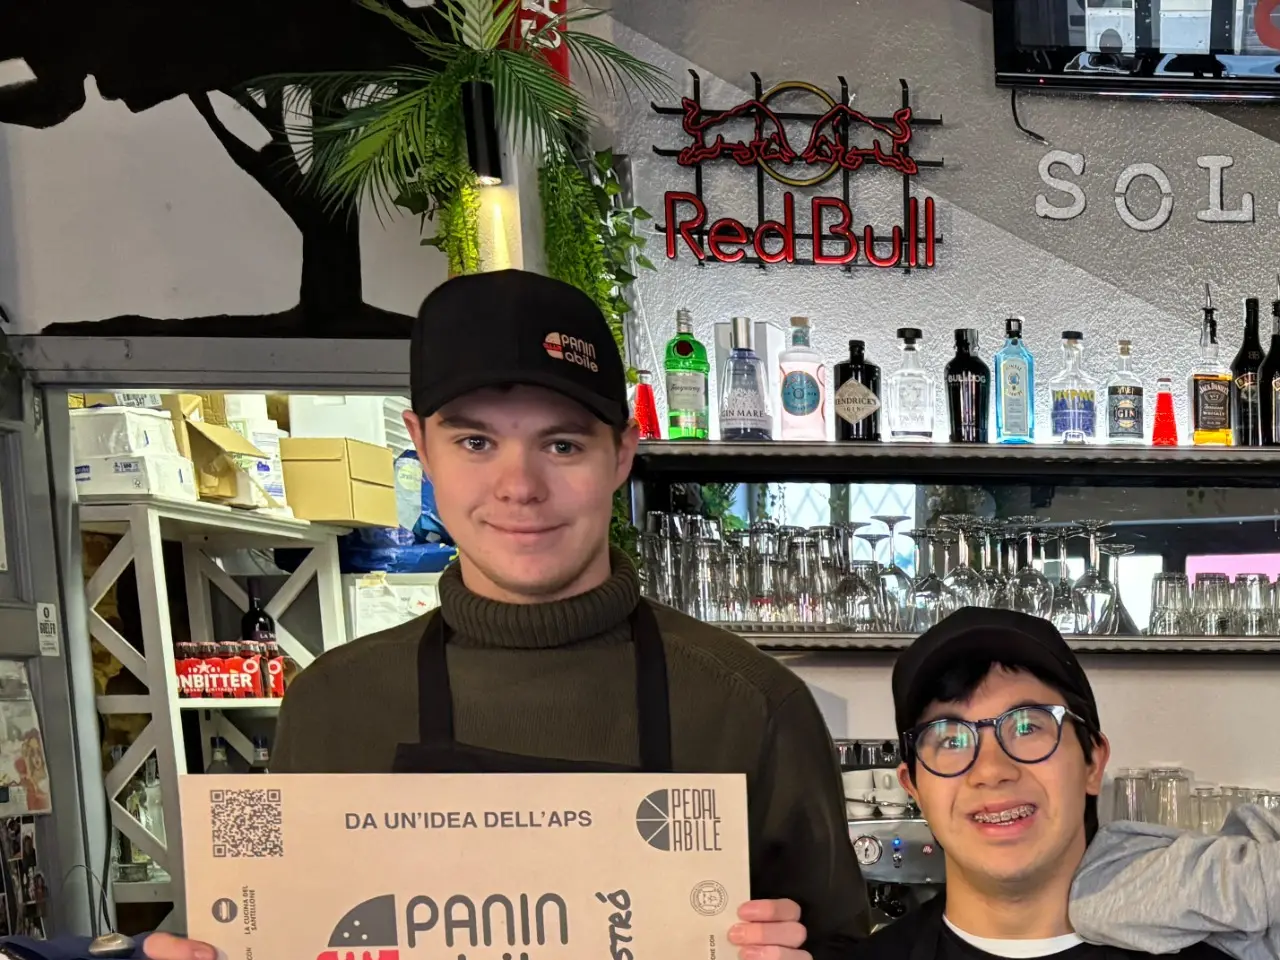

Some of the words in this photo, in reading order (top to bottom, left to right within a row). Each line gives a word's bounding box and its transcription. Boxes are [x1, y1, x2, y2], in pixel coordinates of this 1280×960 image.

[664, 190, 795, 264] Red
[811, 196, 934, 268] Bull
[561, 334, 596, 360] PANIN
[565, 351, 599, 372] abile
[948, 374, 987, 383] BULLDOG
[737, 409, 764, 417] MARE
[1117, 409, 1135, 418] GIN
[672, 789, 721, 820] PEDAL
[344, 811, 379, 831] DA
[384, 810, 477, 830] UN'IDEA
[483, 810, 593, 829] DELL'APS
[672, 820, 723, 852] ABILE
[405, 892, 569, 948] PANIN
